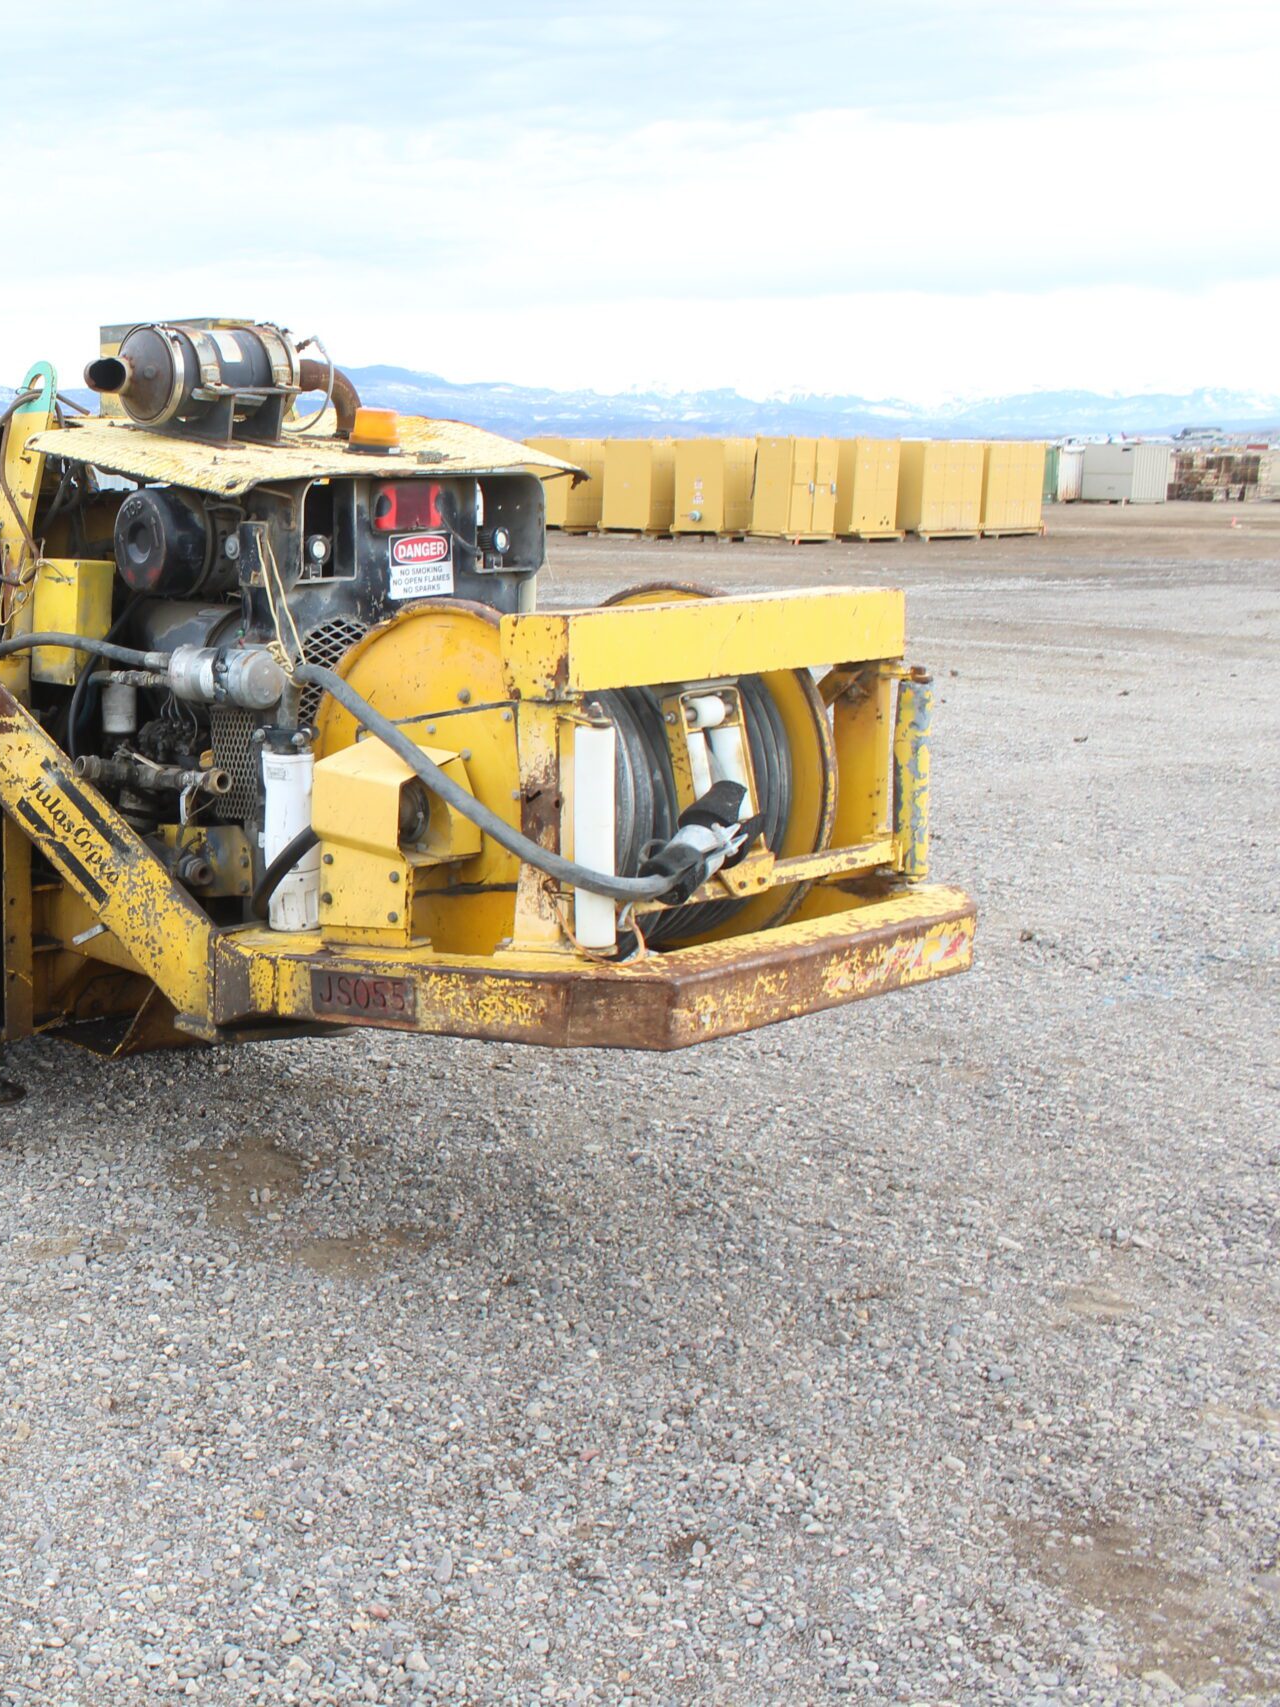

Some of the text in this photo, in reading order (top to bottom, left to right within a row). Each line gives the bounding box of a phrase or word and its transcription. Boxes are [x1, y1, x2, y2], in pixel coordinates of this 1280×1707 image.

[121, 500, 142, 518] TOP
[398, 541, 445, 560] DANGER
[400, 566, 443, 576] NO SMOKING
[404, 577, 422, 585] OPEN
[424, 573, 450, 583] FLAMES
[414, 583, 441, 592] SPARKS
